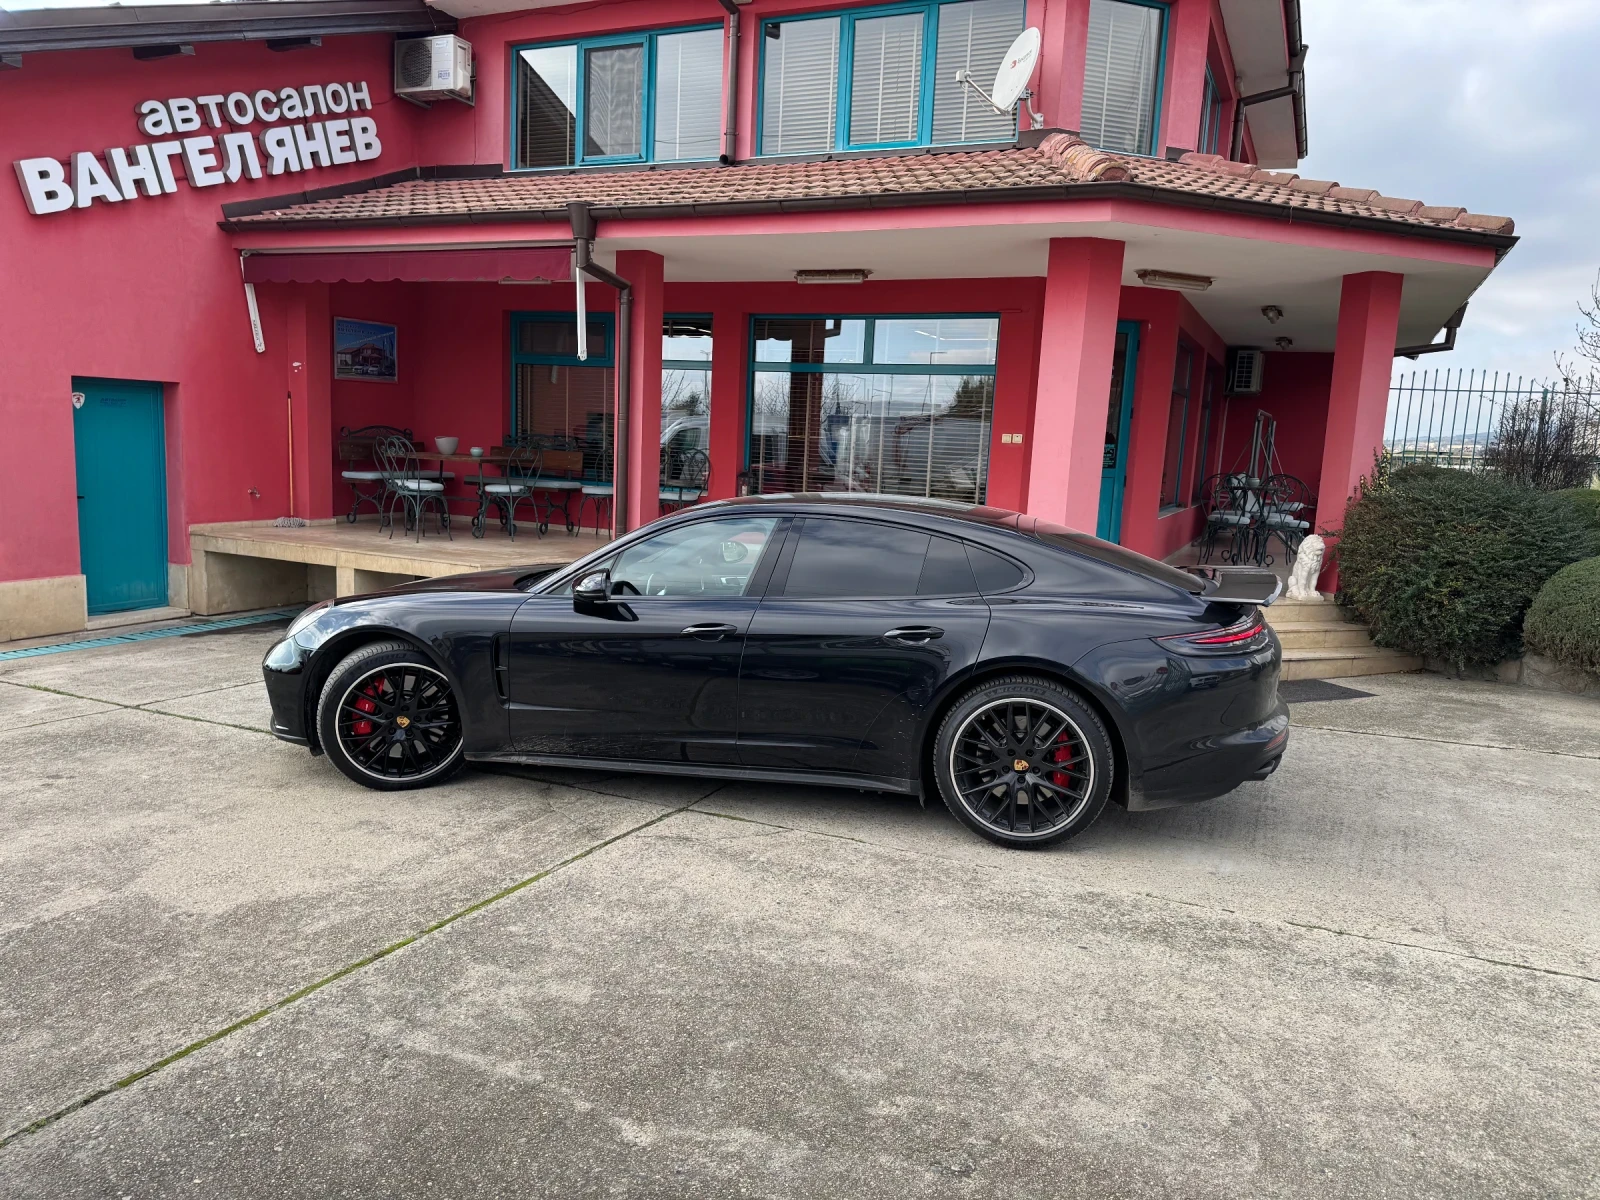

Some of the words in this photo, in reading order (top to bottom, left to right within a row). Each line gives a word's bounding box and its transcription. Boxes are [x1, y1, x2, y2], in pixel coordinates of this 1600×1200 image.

[139, 81, 372, 136] автосалон
[19, 132, 262, 215] ВАНГЕЛ
[264, 117, 382, 175] ЯНЕВ
